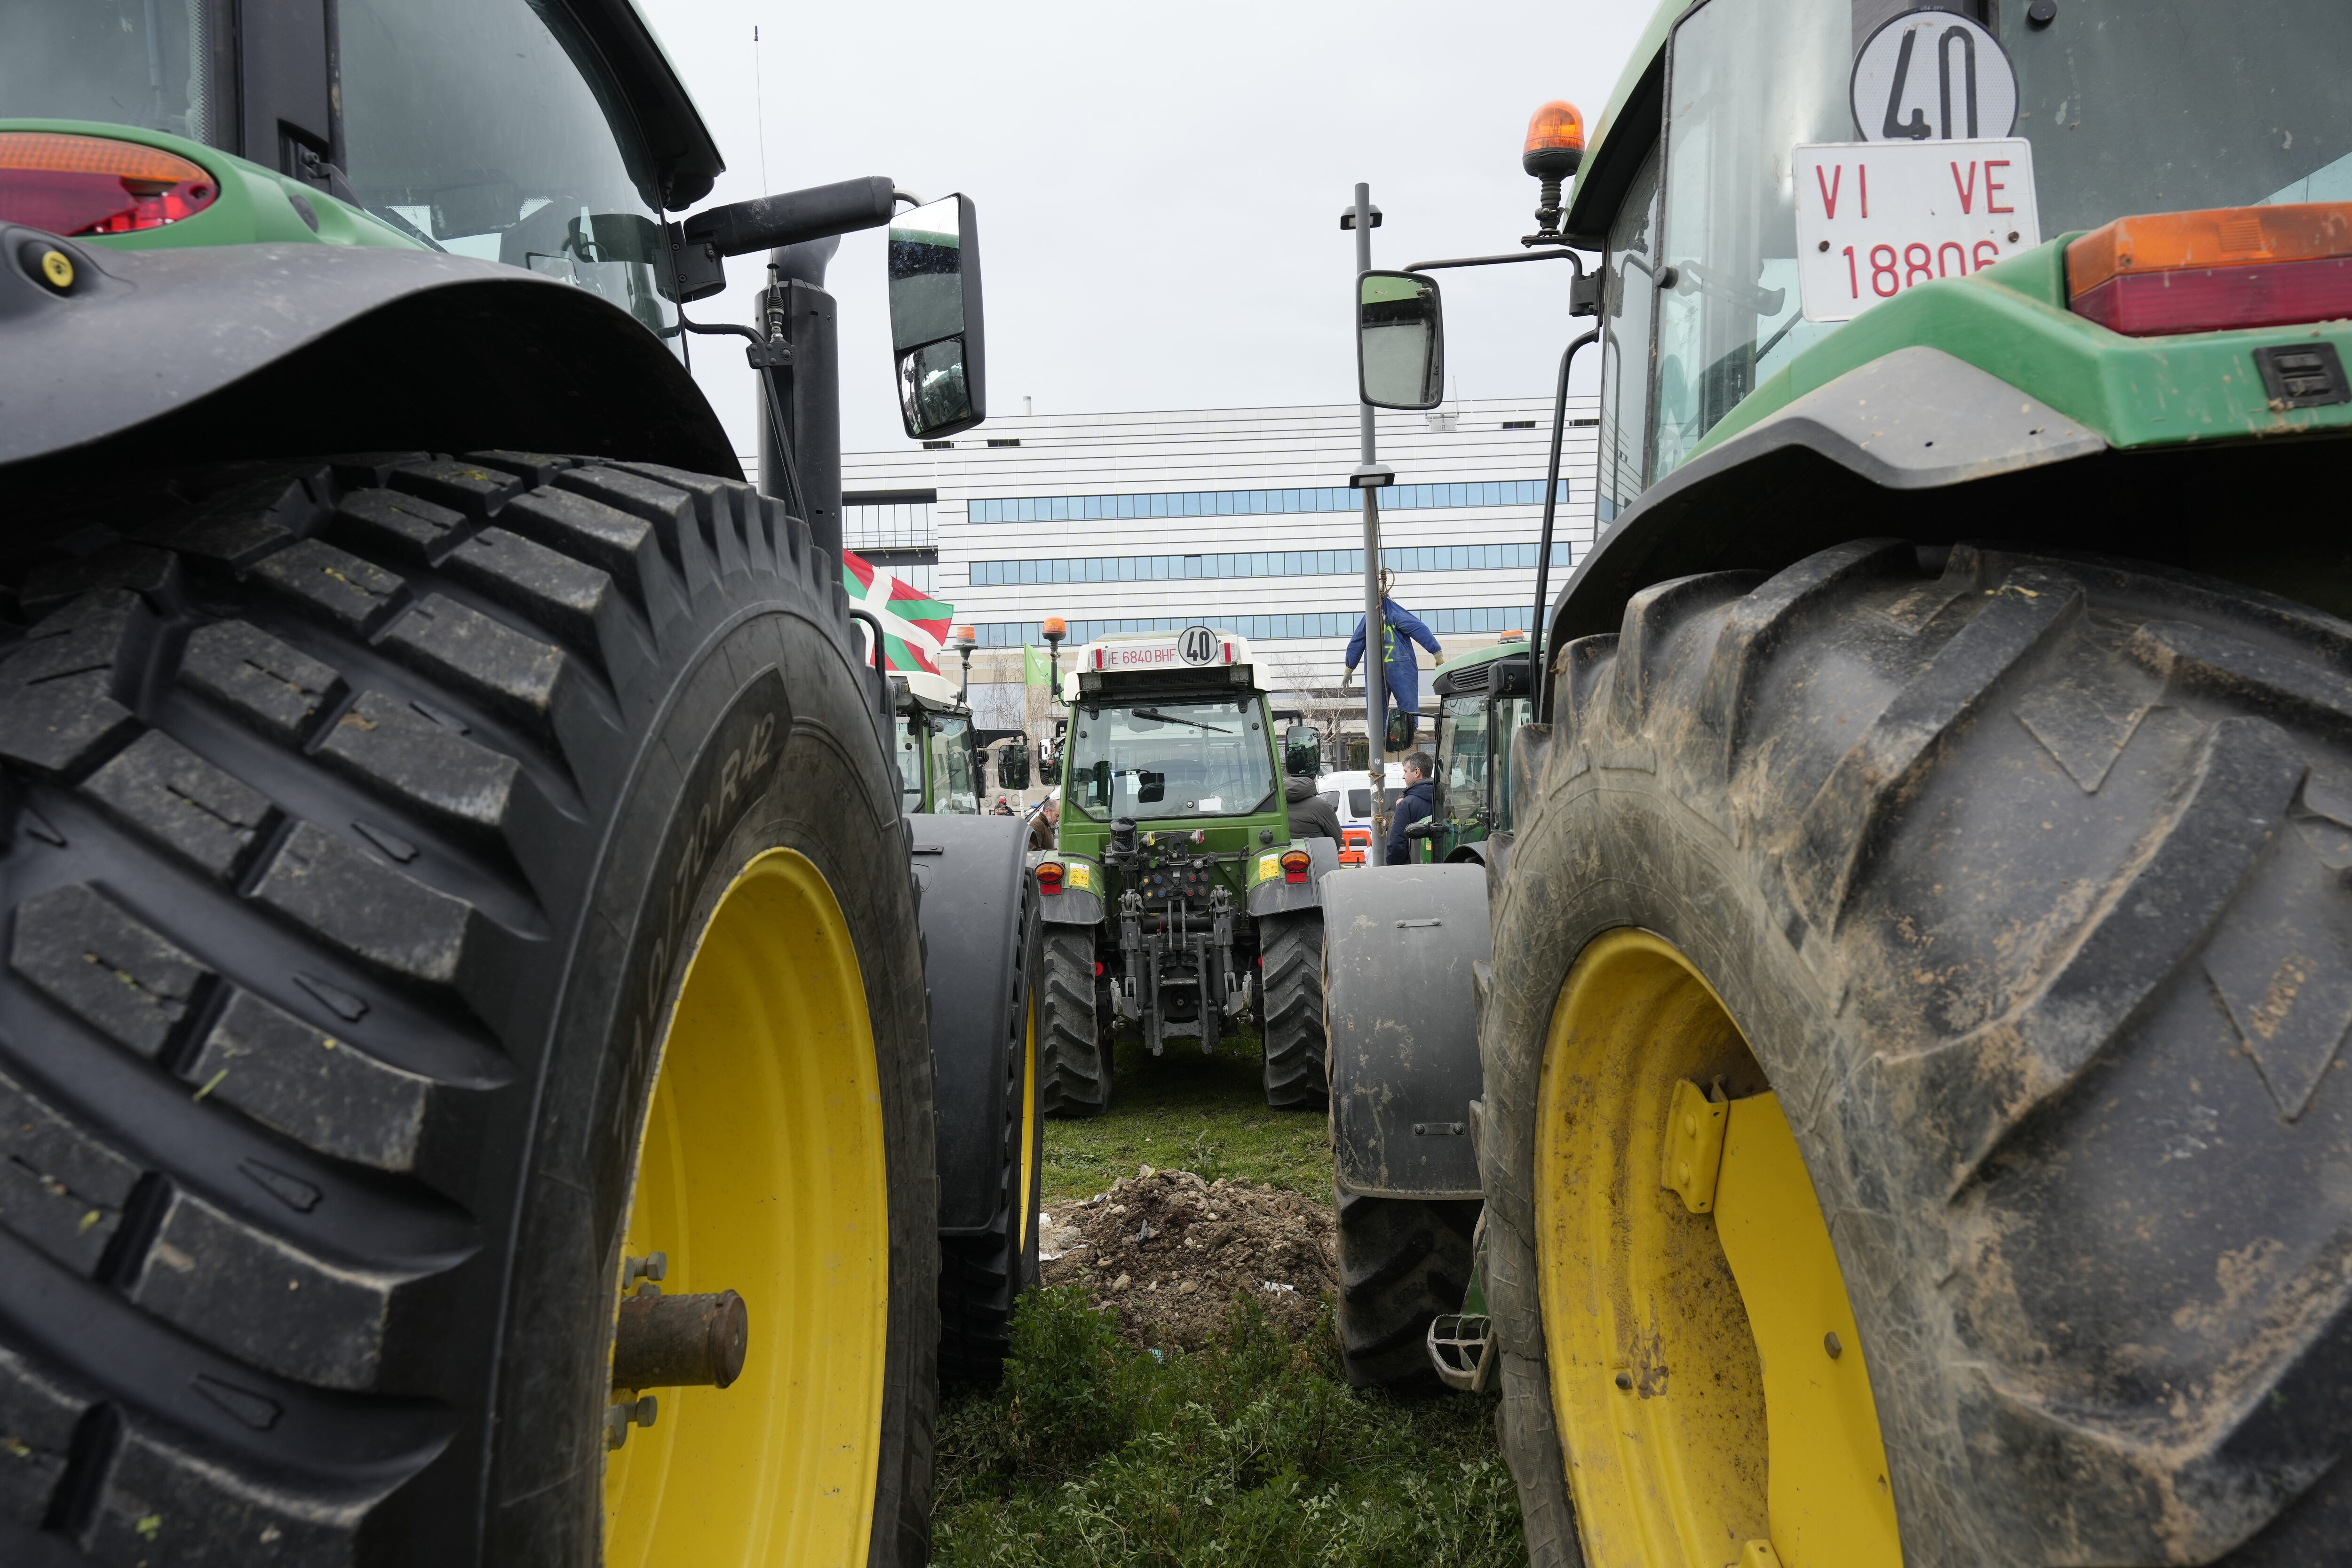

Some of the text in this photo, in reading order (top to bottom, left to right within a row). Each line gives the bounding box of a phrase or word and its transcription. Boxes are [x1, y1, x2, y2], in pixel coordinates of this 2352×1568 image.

[1883, 25, 1978, 140] 40
[1816, 160, 2014, 219] VI VE
[1843, 240, 1999, 298] 18806
[1111, 648, 1176, 665] E 6840 BHF
[1186, 630, 1210, 661] 40
[716, 711, 775, 828] R42
